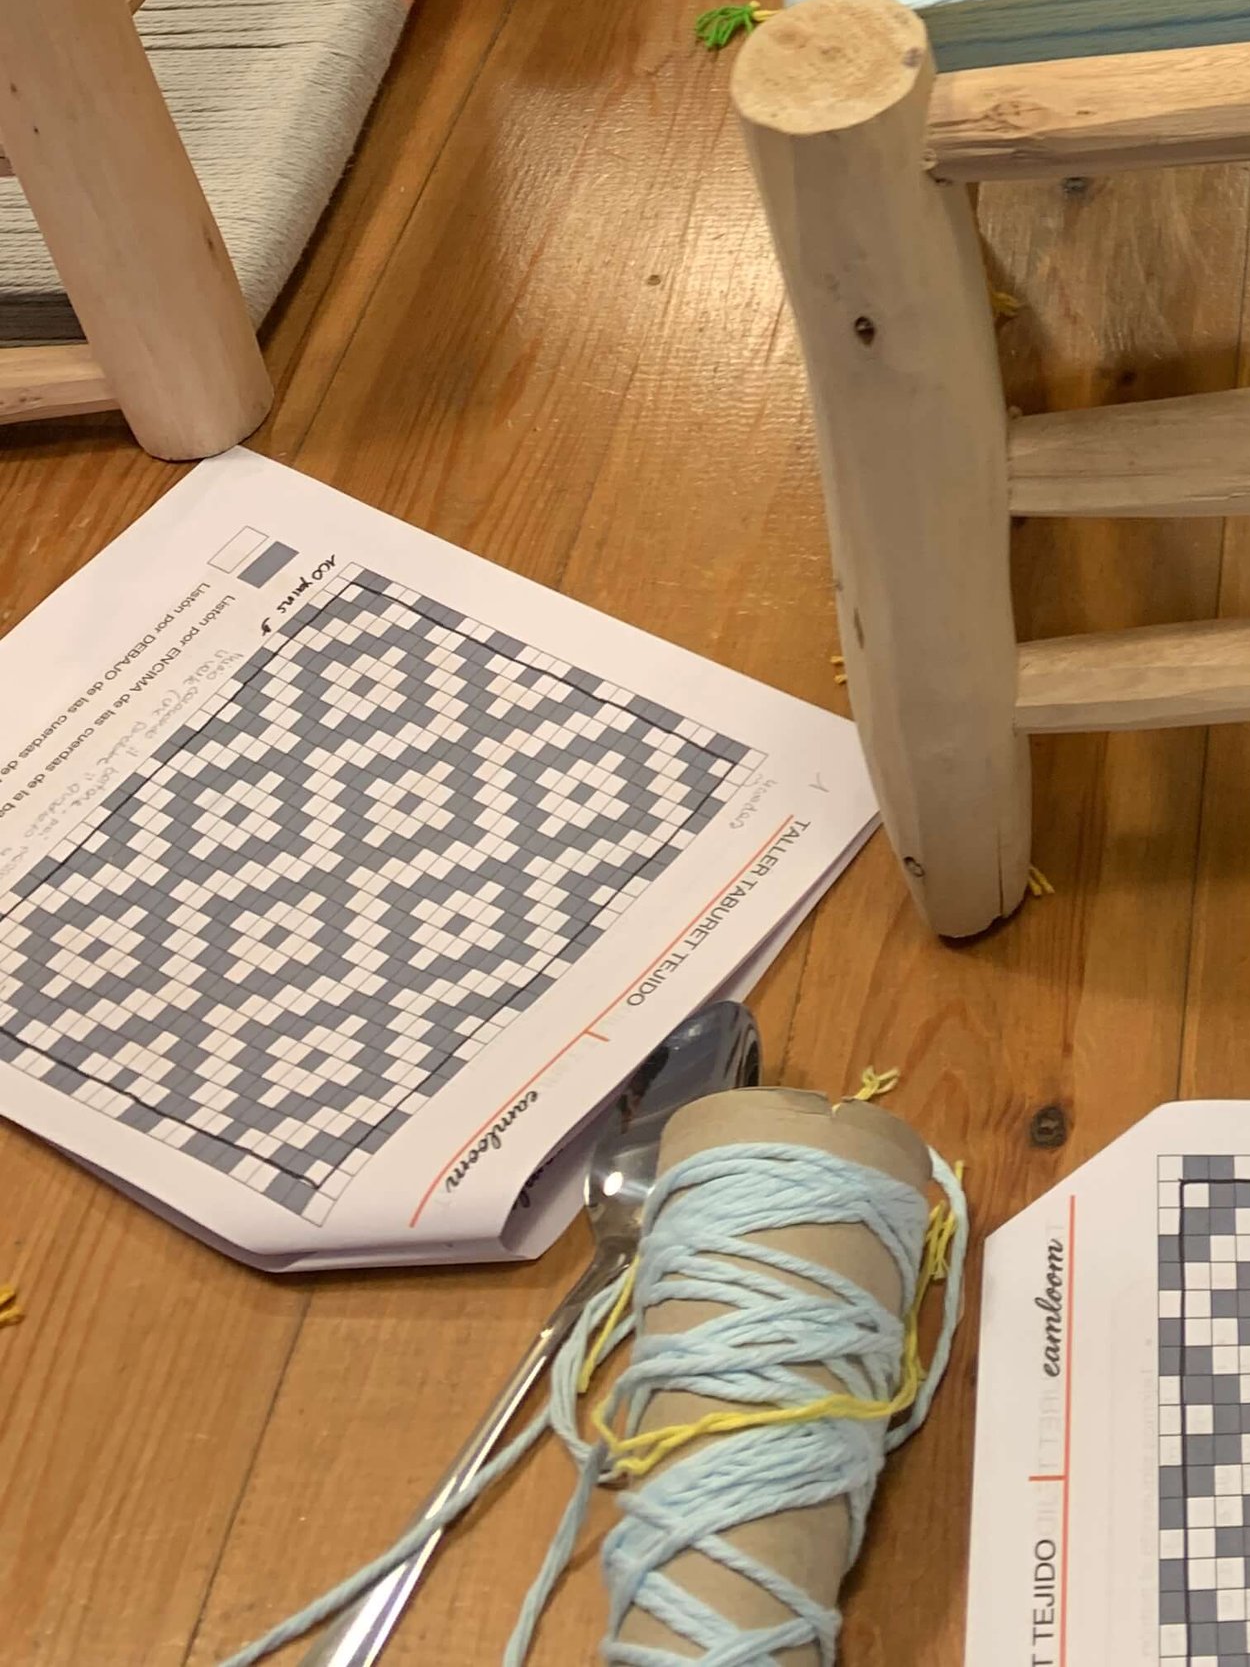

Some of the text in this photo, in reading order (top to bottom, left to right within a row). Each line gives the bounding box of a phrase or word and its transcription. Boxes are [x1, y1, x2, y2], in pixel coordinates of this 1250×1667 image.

[312, 553, 336, 580] 100
[198, 594, 236, 627] Listón
[179, 626, 201, 647] por
[0, 582, 211, 776] Listón por DEBAJO de las cuerdas de
[129, 647, 182, 693] ENCIMA
[112, 693, 131, 709] de
[94, 709, 117, 727] las
[45, 727, 95, 773] cuerdas
[27, 773, 46, 789] de
[12, 790, 30, 803] la
[626, 820, 812, 1007] TALLER TABURET TEJIDO
[1032, 1539, 1056, 1646] TEJIDO
